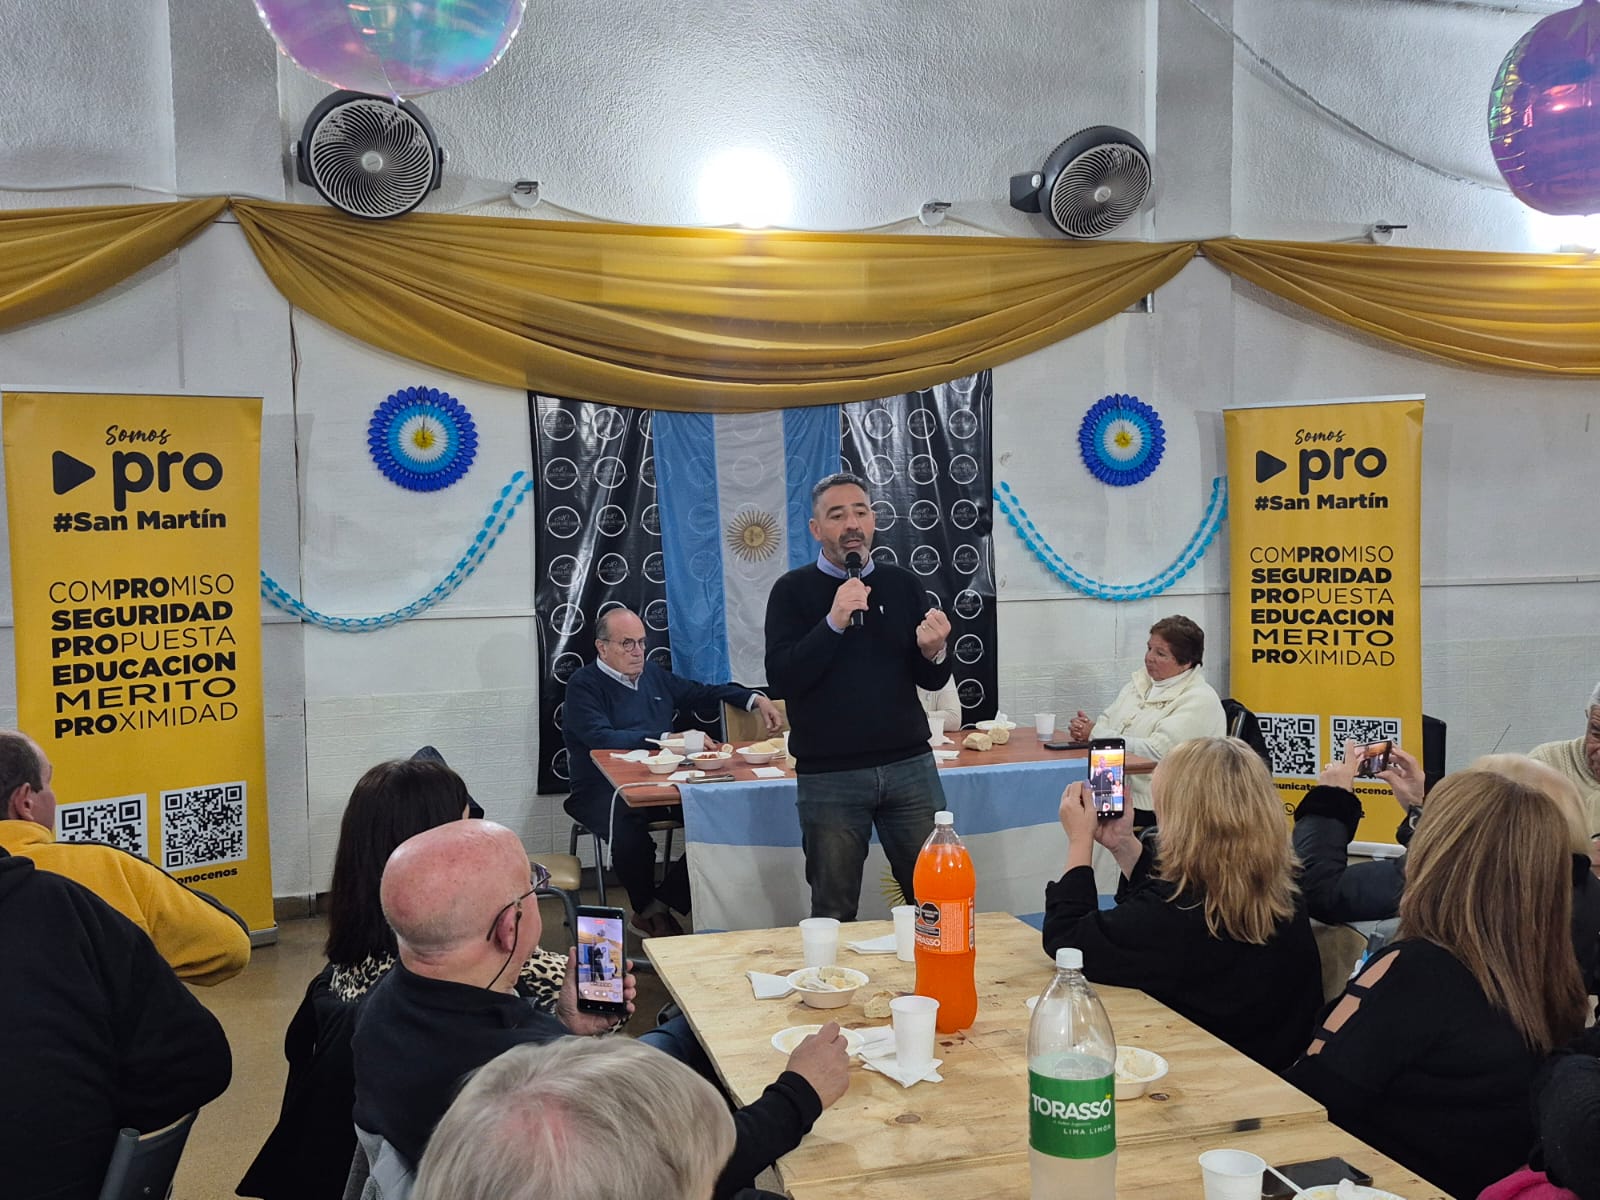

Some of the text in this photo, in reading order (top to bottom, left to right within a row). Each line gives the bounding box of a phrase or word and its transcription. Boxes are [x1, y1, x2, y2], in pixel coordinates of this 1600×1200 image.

[105, 424, 171, 446] Somos
[1295, 429, 1346, 445] Somos
[112, 450, 223, 512] pro
[1299, 447, 1387, 495] pro
[1255, 492, 1389, 511] #San Martín
[53, 508, 226, 533] #San Martín
[1250, 545, 1394, 563] COMPROMISO
[1251, 567, 1392, 584] SEGURIDAD
[49, 573, 234, 604] COMPROMISO
[1251, 587, 1394, 605] PROPUESTA
[51, 600, 233, 631] SEGURIDAD
[1251, 608, 1394, 626] EDUCACION
[52, 625, 236, 659] PROPUESTA
[1253, 628, 1394, 647] MERITO
[53, 651, 236, 686] EDUCACION
[1252, 648, 1395, 667] PROXIMIDAD
[55, 677, 237, 714] MERITO
[54, 702, 239, 739] PROXIMIDAD
[177, 868, 238, 884] onocenos
[1031, 1093, 1112, 1121] TORASSO
